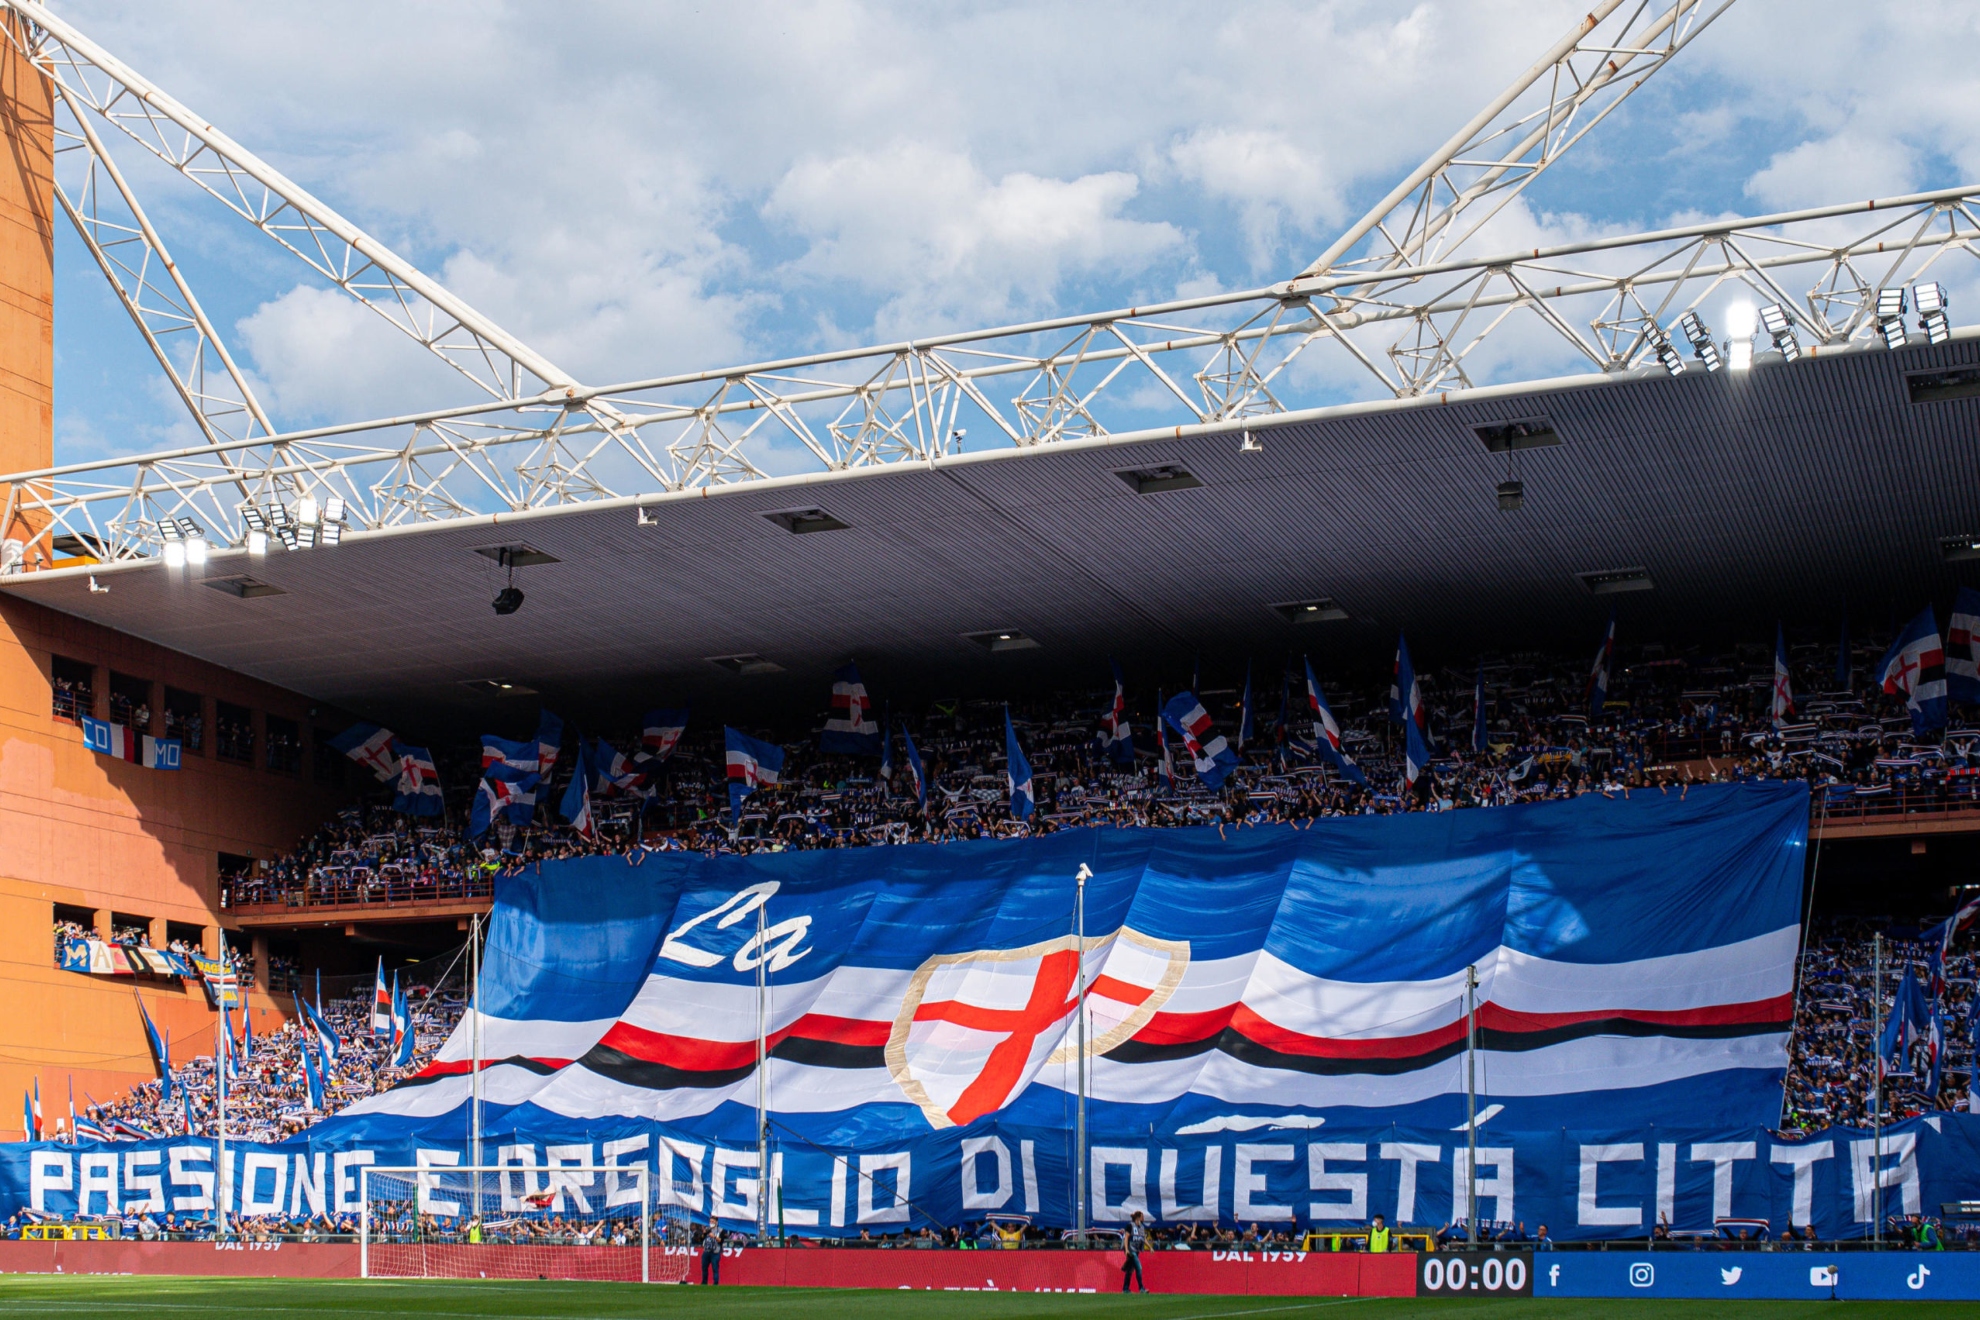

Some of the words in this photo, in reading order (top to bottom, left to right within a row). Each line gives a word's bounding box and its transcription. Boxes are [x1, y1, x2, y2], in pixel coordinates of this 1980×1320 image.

[29, 1145, 375, 1217] PASSIONE
[417, 1148, 461, 1217] E
[499, 1132, 911, 1227] ORGOGLIO
[960, 1135, 1040, 1213] DI
[1090, 1142, 1514, 1226] QUESTA
[1423, 1258, 1527, 1291] 00:00
